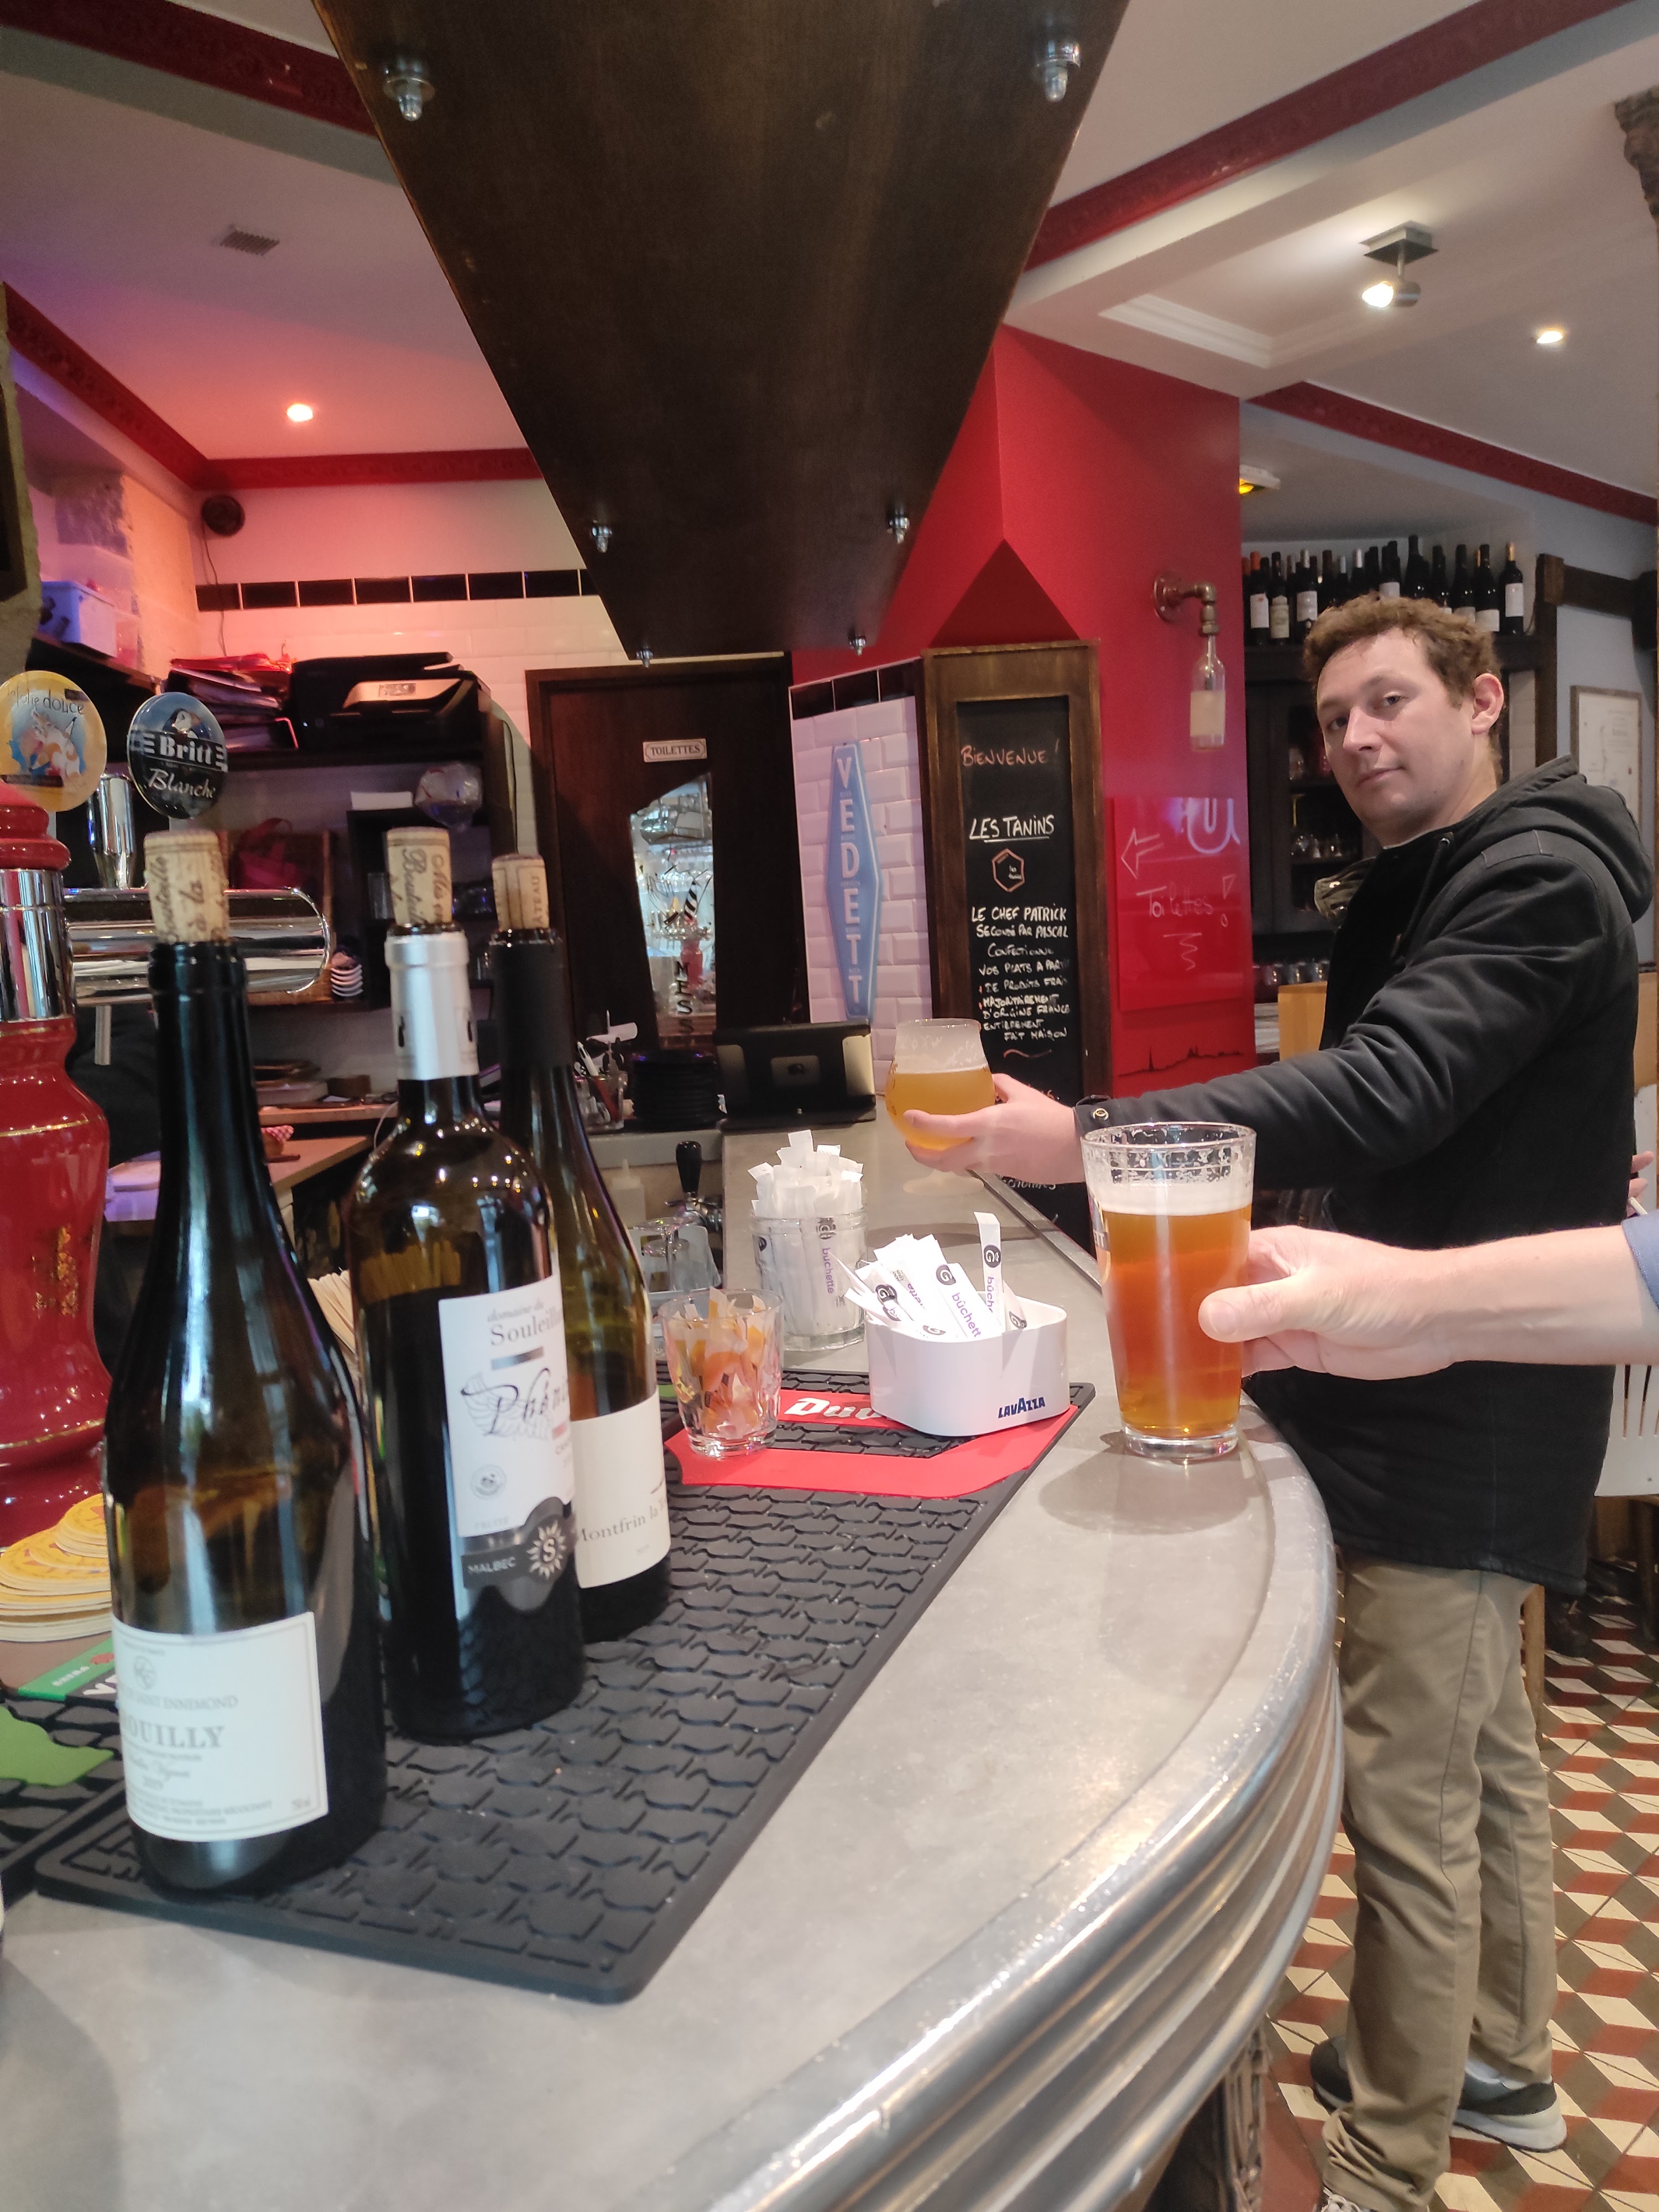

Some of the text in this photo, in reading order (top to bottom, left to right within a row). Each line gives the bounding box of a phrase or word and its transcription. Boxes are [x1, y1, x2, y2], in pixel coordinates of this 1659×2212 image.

[43, 688, 85, 715] douce
[159, 736, 212, 765] Britt
[650, 744, 701, 756] TOILETTES
[148, 768, 216, 799] Blanche
[969, 818, 1000, 840] LES
[836, 757, 863, 1004] VEDETT
[971, 906, 987, 922] LE
[992, 906, 1021, 920] CHEF
[1019, 923, 1033, 936] PAR
[1035, 925, 1068, 939] PASCAL
[979, 963, 1000, 976] VOS
[1036, 961, 1044, 972] A
[1036, 1004, 1071, 1015] FRANCE
[1004, 1027, 1067, 1041] FAIT MAISON
[998, 1396, 1046, 1419] LAVAZZA
